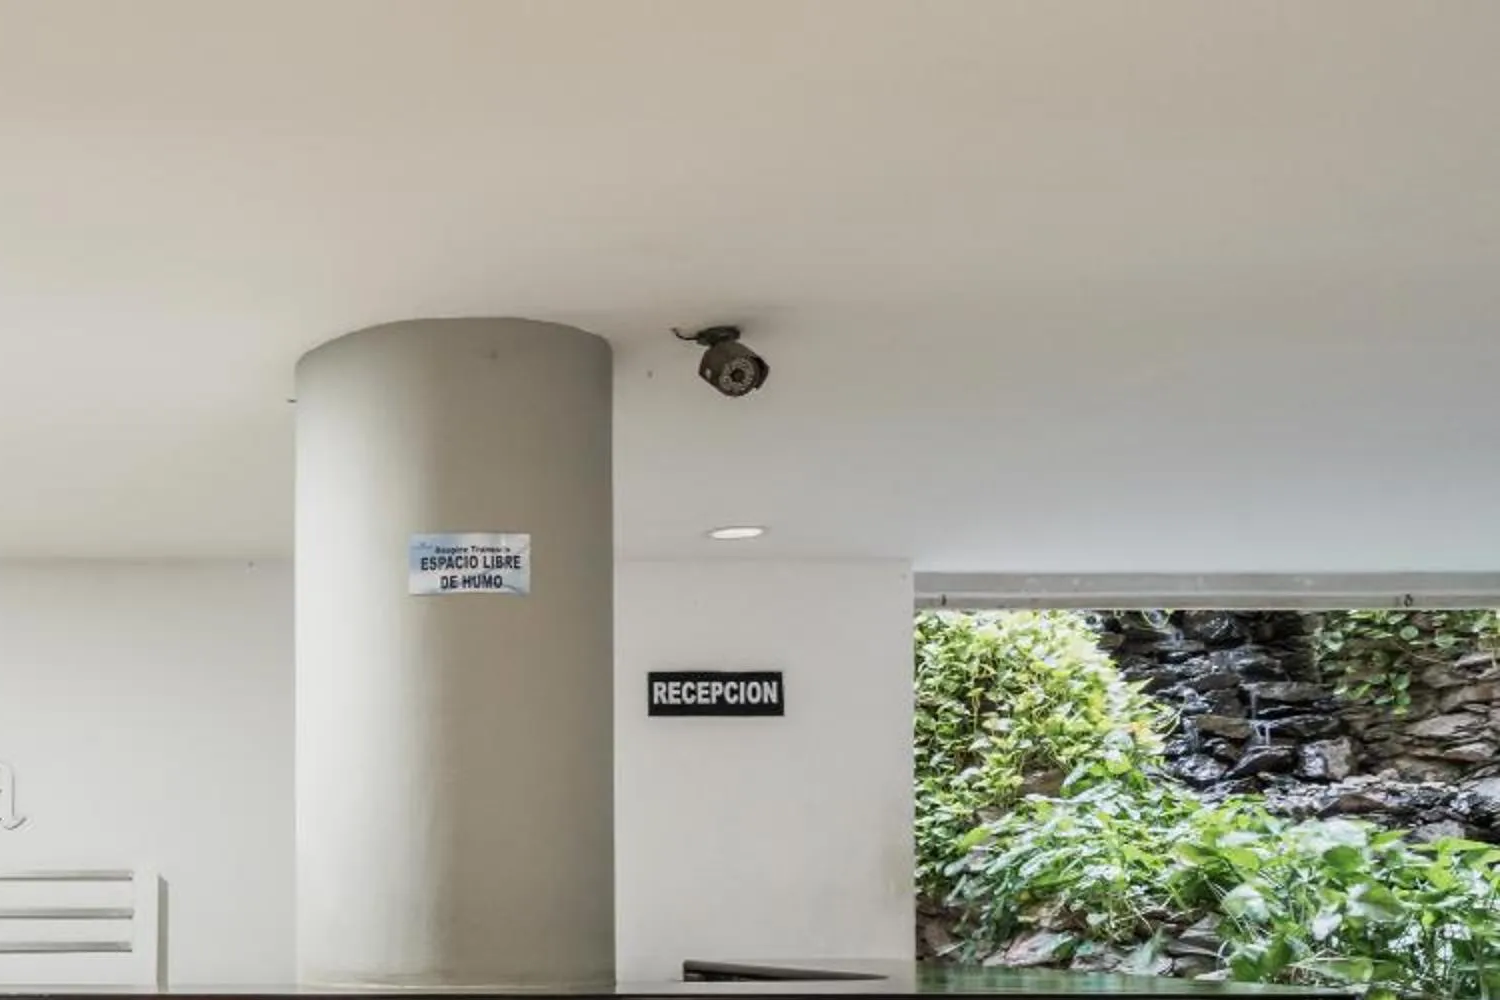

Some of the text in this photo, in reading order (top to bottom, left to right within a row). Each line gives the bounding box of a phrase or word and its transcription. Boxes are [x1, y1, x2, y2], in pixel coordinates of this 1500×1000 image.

[421, 555, 521, 570] ESPACIO LIBRE
[440, 575, 503, 589] DE HUMO
[653, 681, 778, 704] RECEPCION
